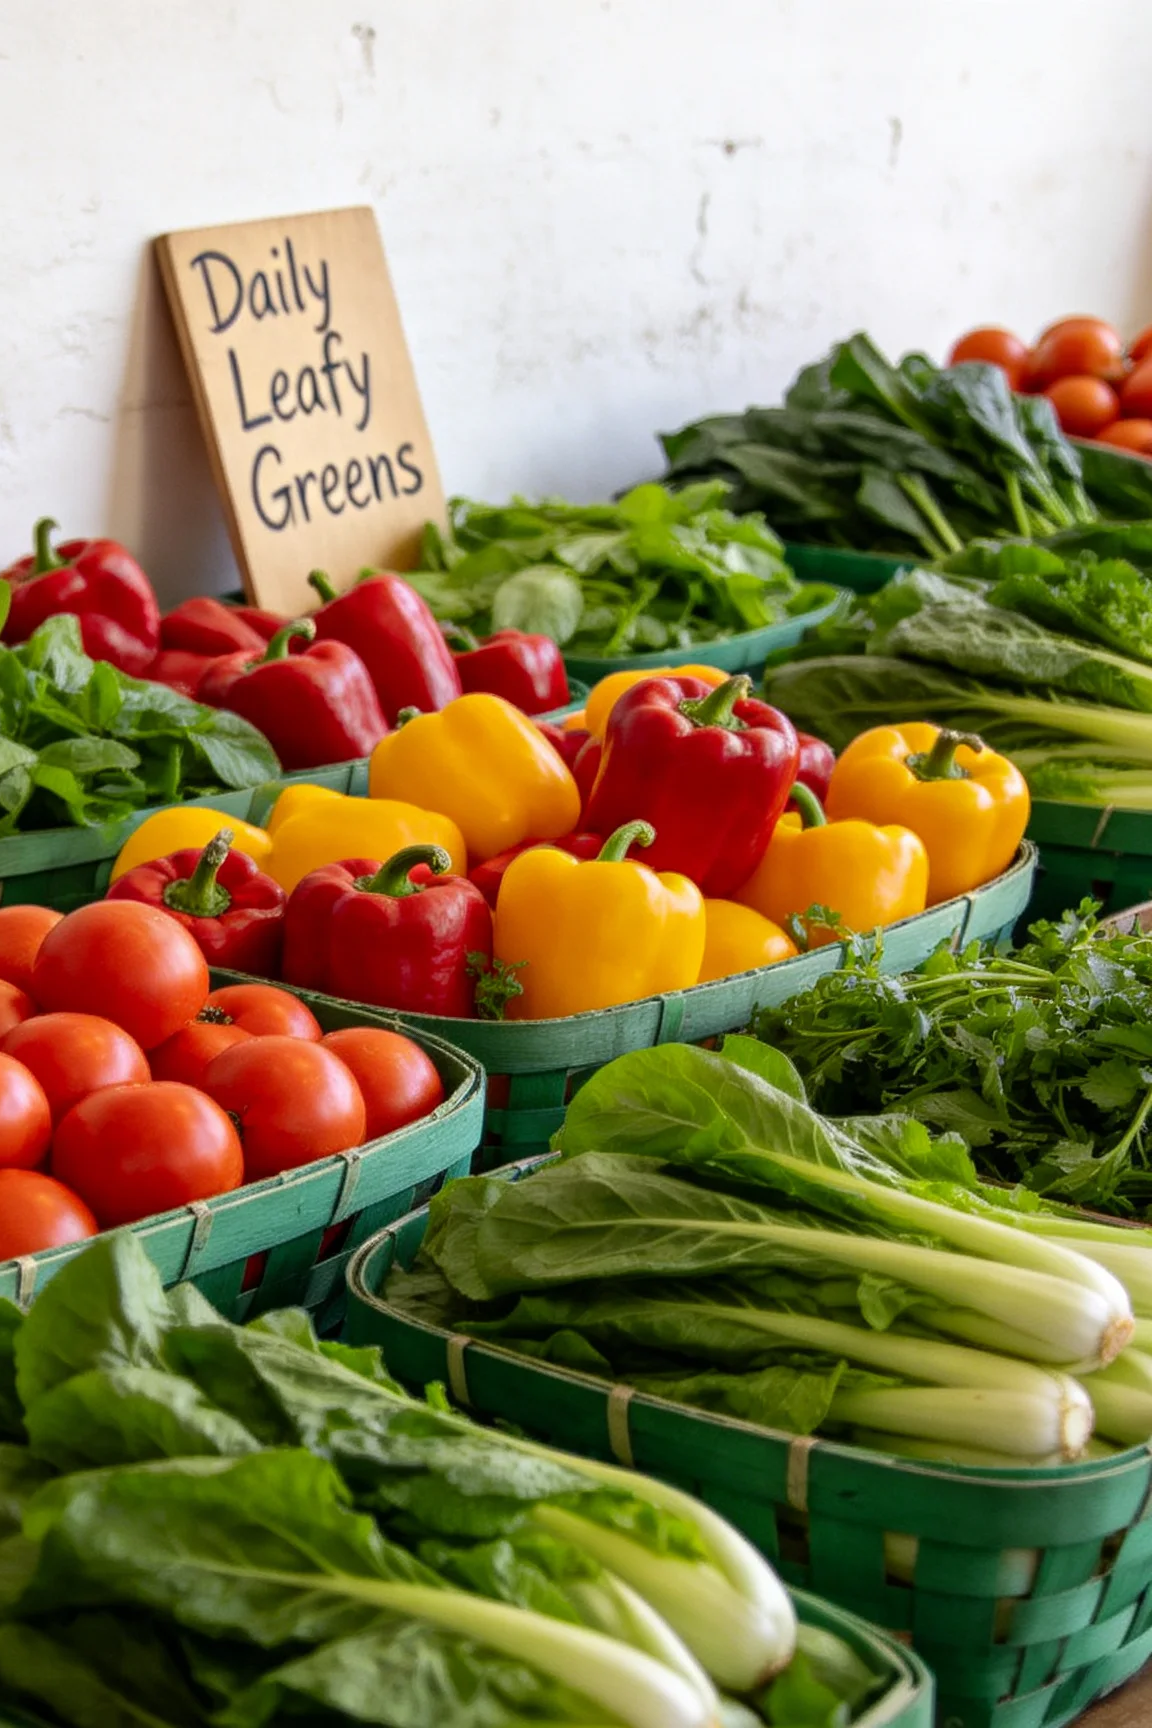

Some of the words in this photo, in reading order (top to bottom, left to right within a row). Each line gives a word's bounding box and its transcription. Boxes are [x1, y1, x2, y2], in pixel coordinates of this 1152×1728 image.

[191, 238, 331, 332] Daily
[228, 331, 372, 432] Leafy
[250, 443, 424, 531] Greens
